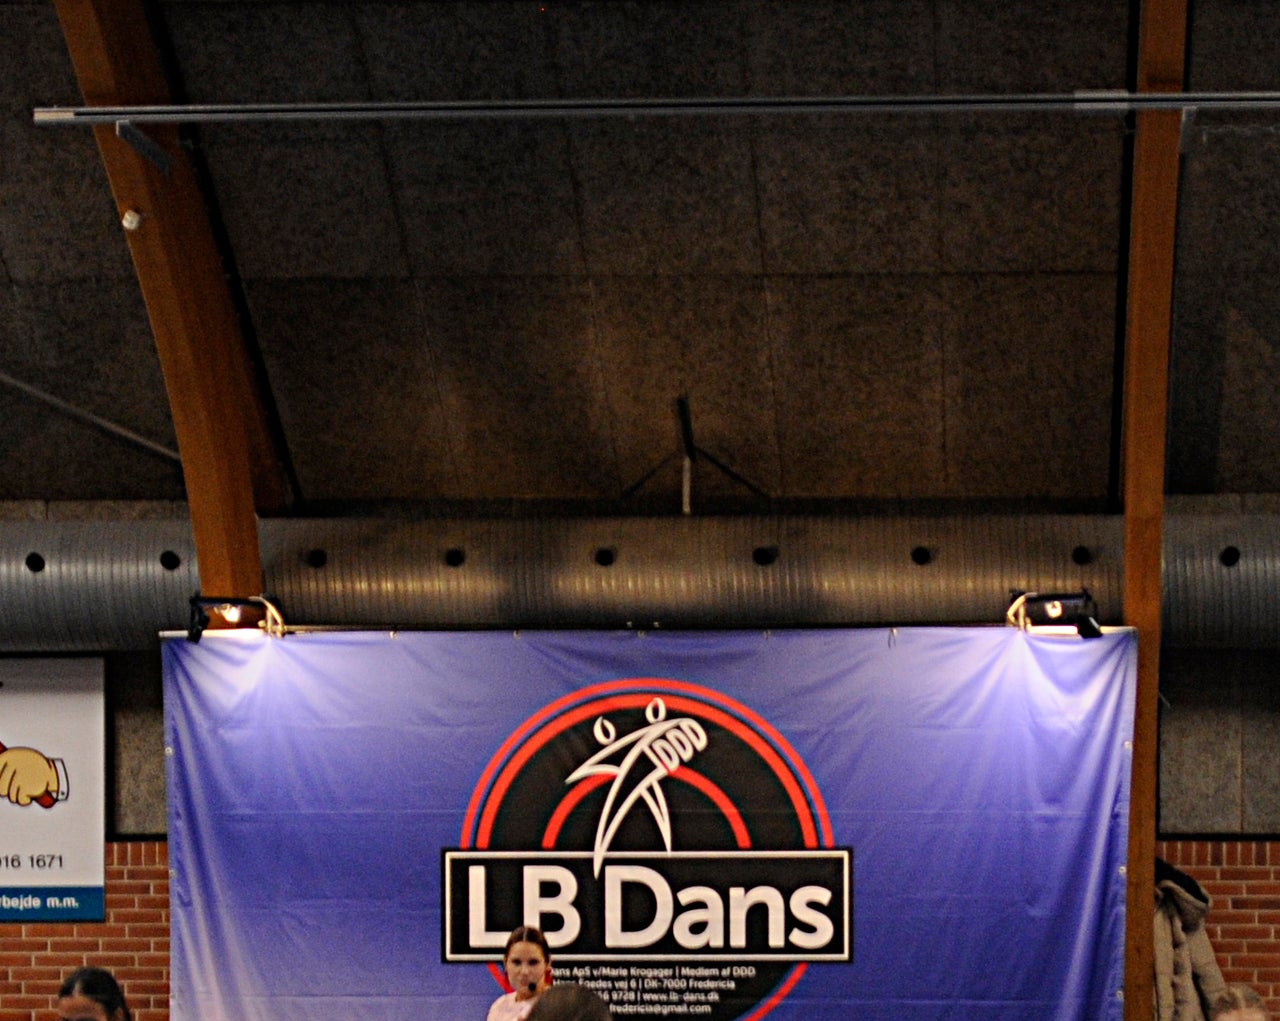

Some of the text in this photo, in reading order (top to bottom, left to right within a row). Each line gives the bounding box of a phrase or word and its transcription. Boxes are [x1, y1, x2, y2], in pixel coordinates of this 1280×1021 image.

[29, 854, 63, 868] 1671
[46, 897, 79, 909] m.m.
[468, 865, 834, 949] LB Dans
[572, 966, 591, 979] ApS
[630, 967, 673, 979] Krogager
[681, 967, 720, 977] Medlem
[721, 967, 730, 977] af
[732, 967, 755, 977] DDD
[614, 980, 628, 991] vej
[644, 979, 687, 989] DK-7000
[689, 979, 736, 990] Fredericia
[643, 991, 719, 1002] www.lb-dans.dk
[609, 1003, 711, 1016] fredericia@gmail.com
